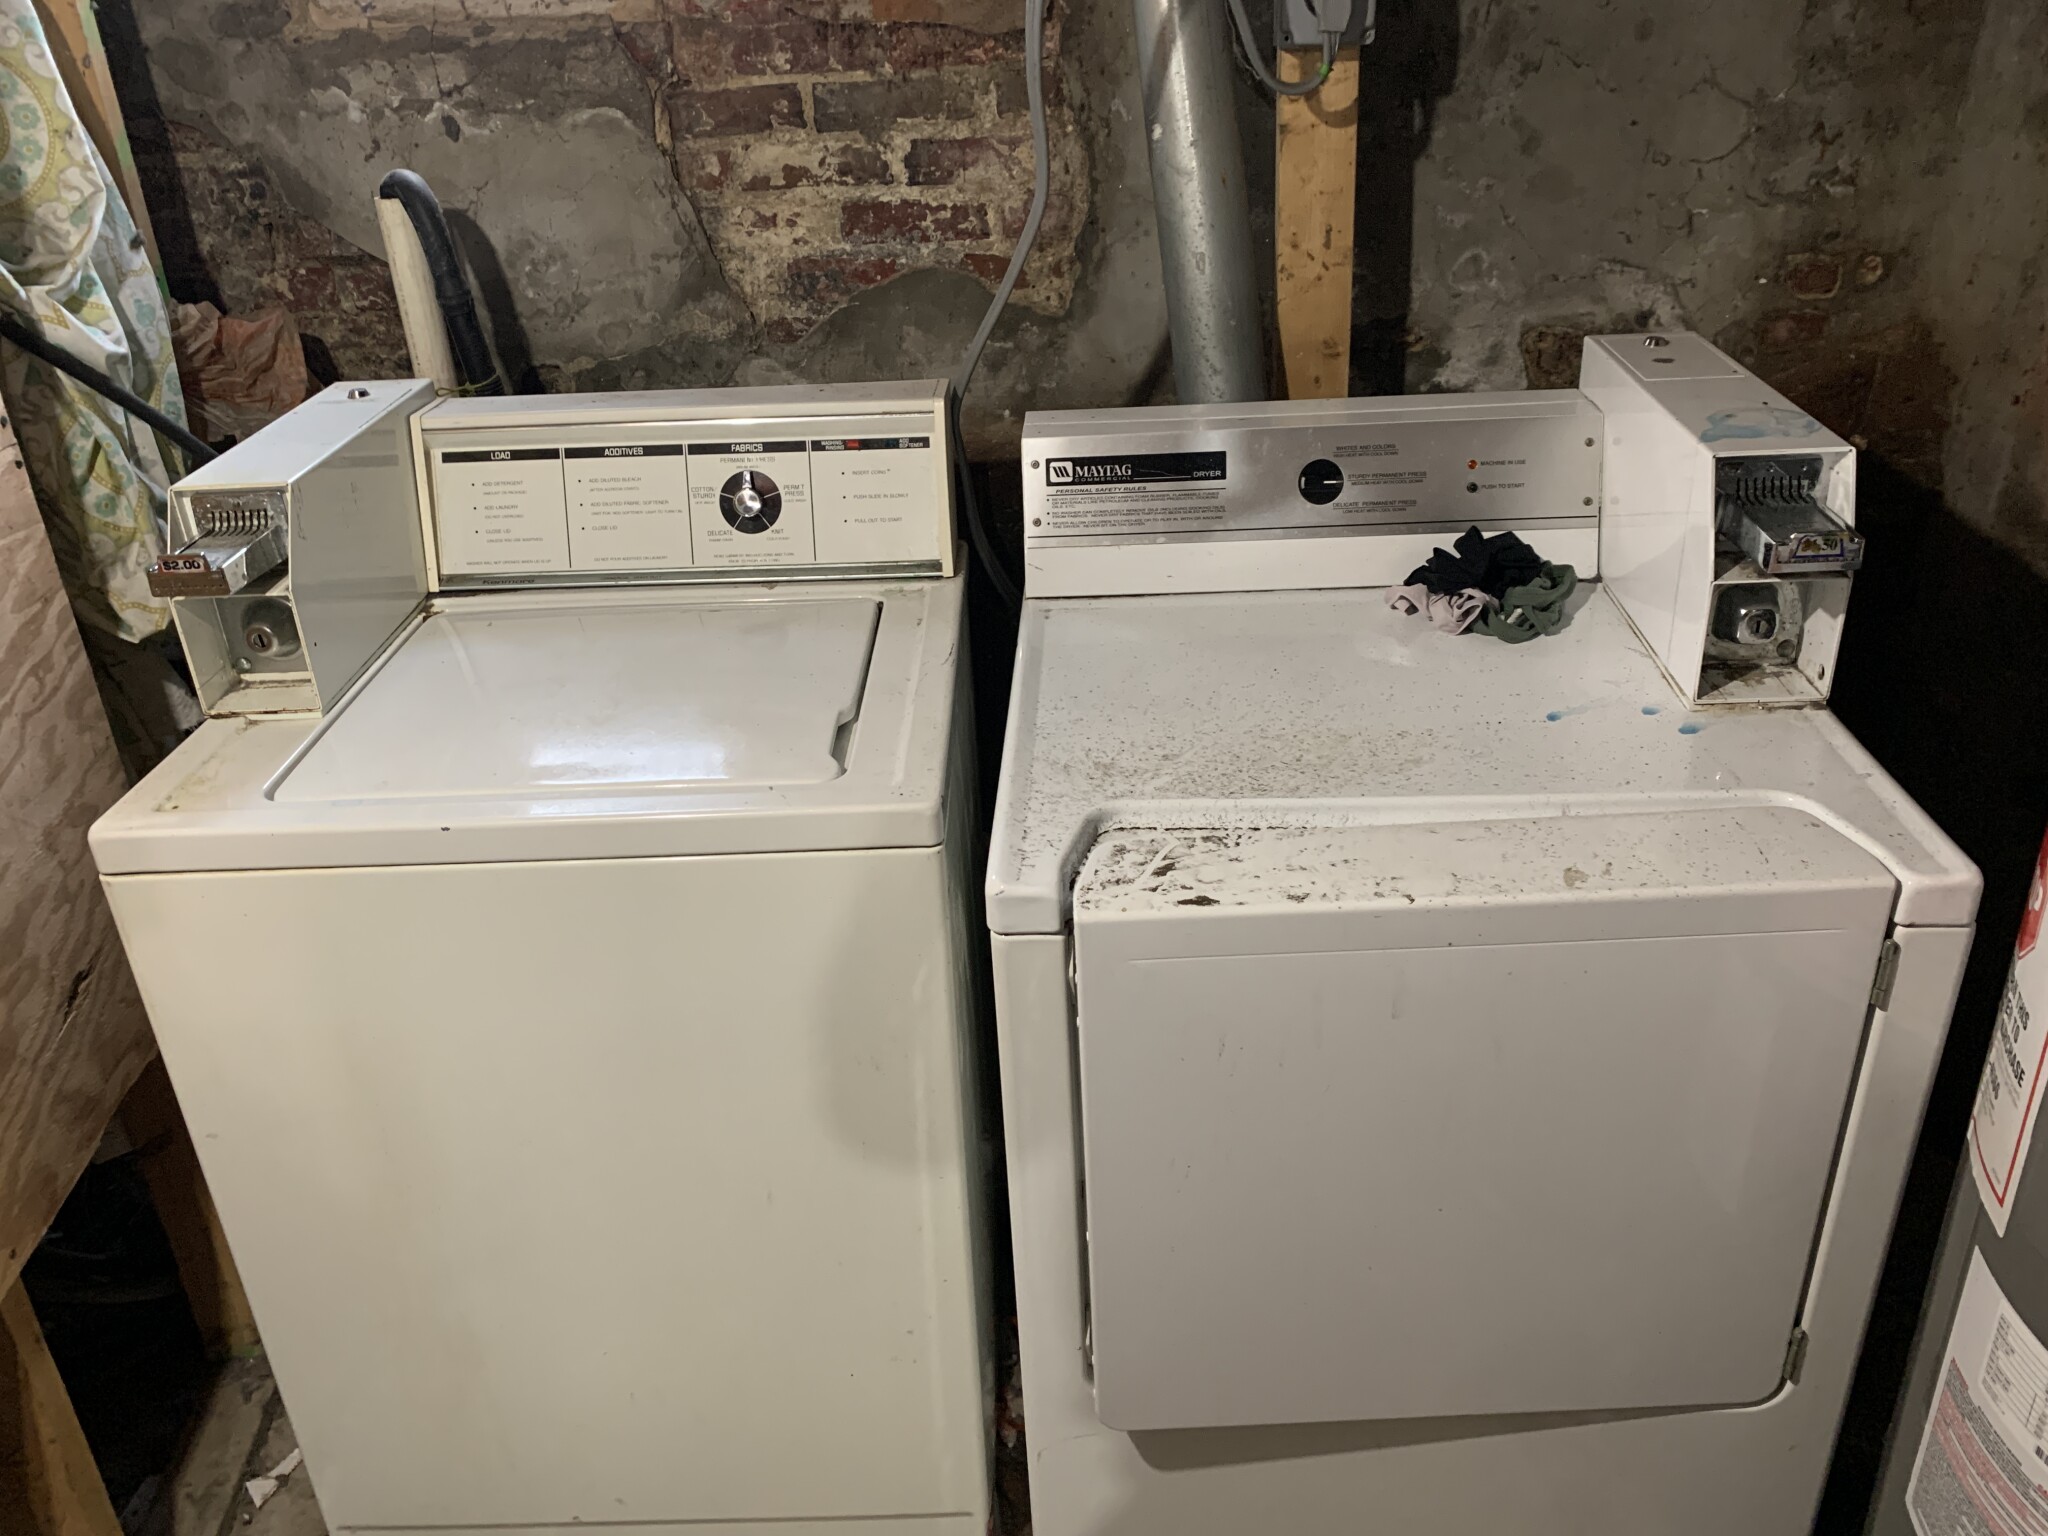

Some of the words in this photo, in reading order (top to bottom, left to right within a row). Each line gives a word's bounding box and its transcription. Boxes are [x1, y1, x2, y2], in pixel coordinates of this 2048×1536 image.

[604, 447, 644, 456] ADDITIVES
[731, 444, 763, 452] FABRICS
[490, 451, 511, 460] LOAD
[1075, 464, 1132, 478] MAYTAG
[1193, 470, 1222, 478] DRYER
[162, 560, 201, 570] $2.00
